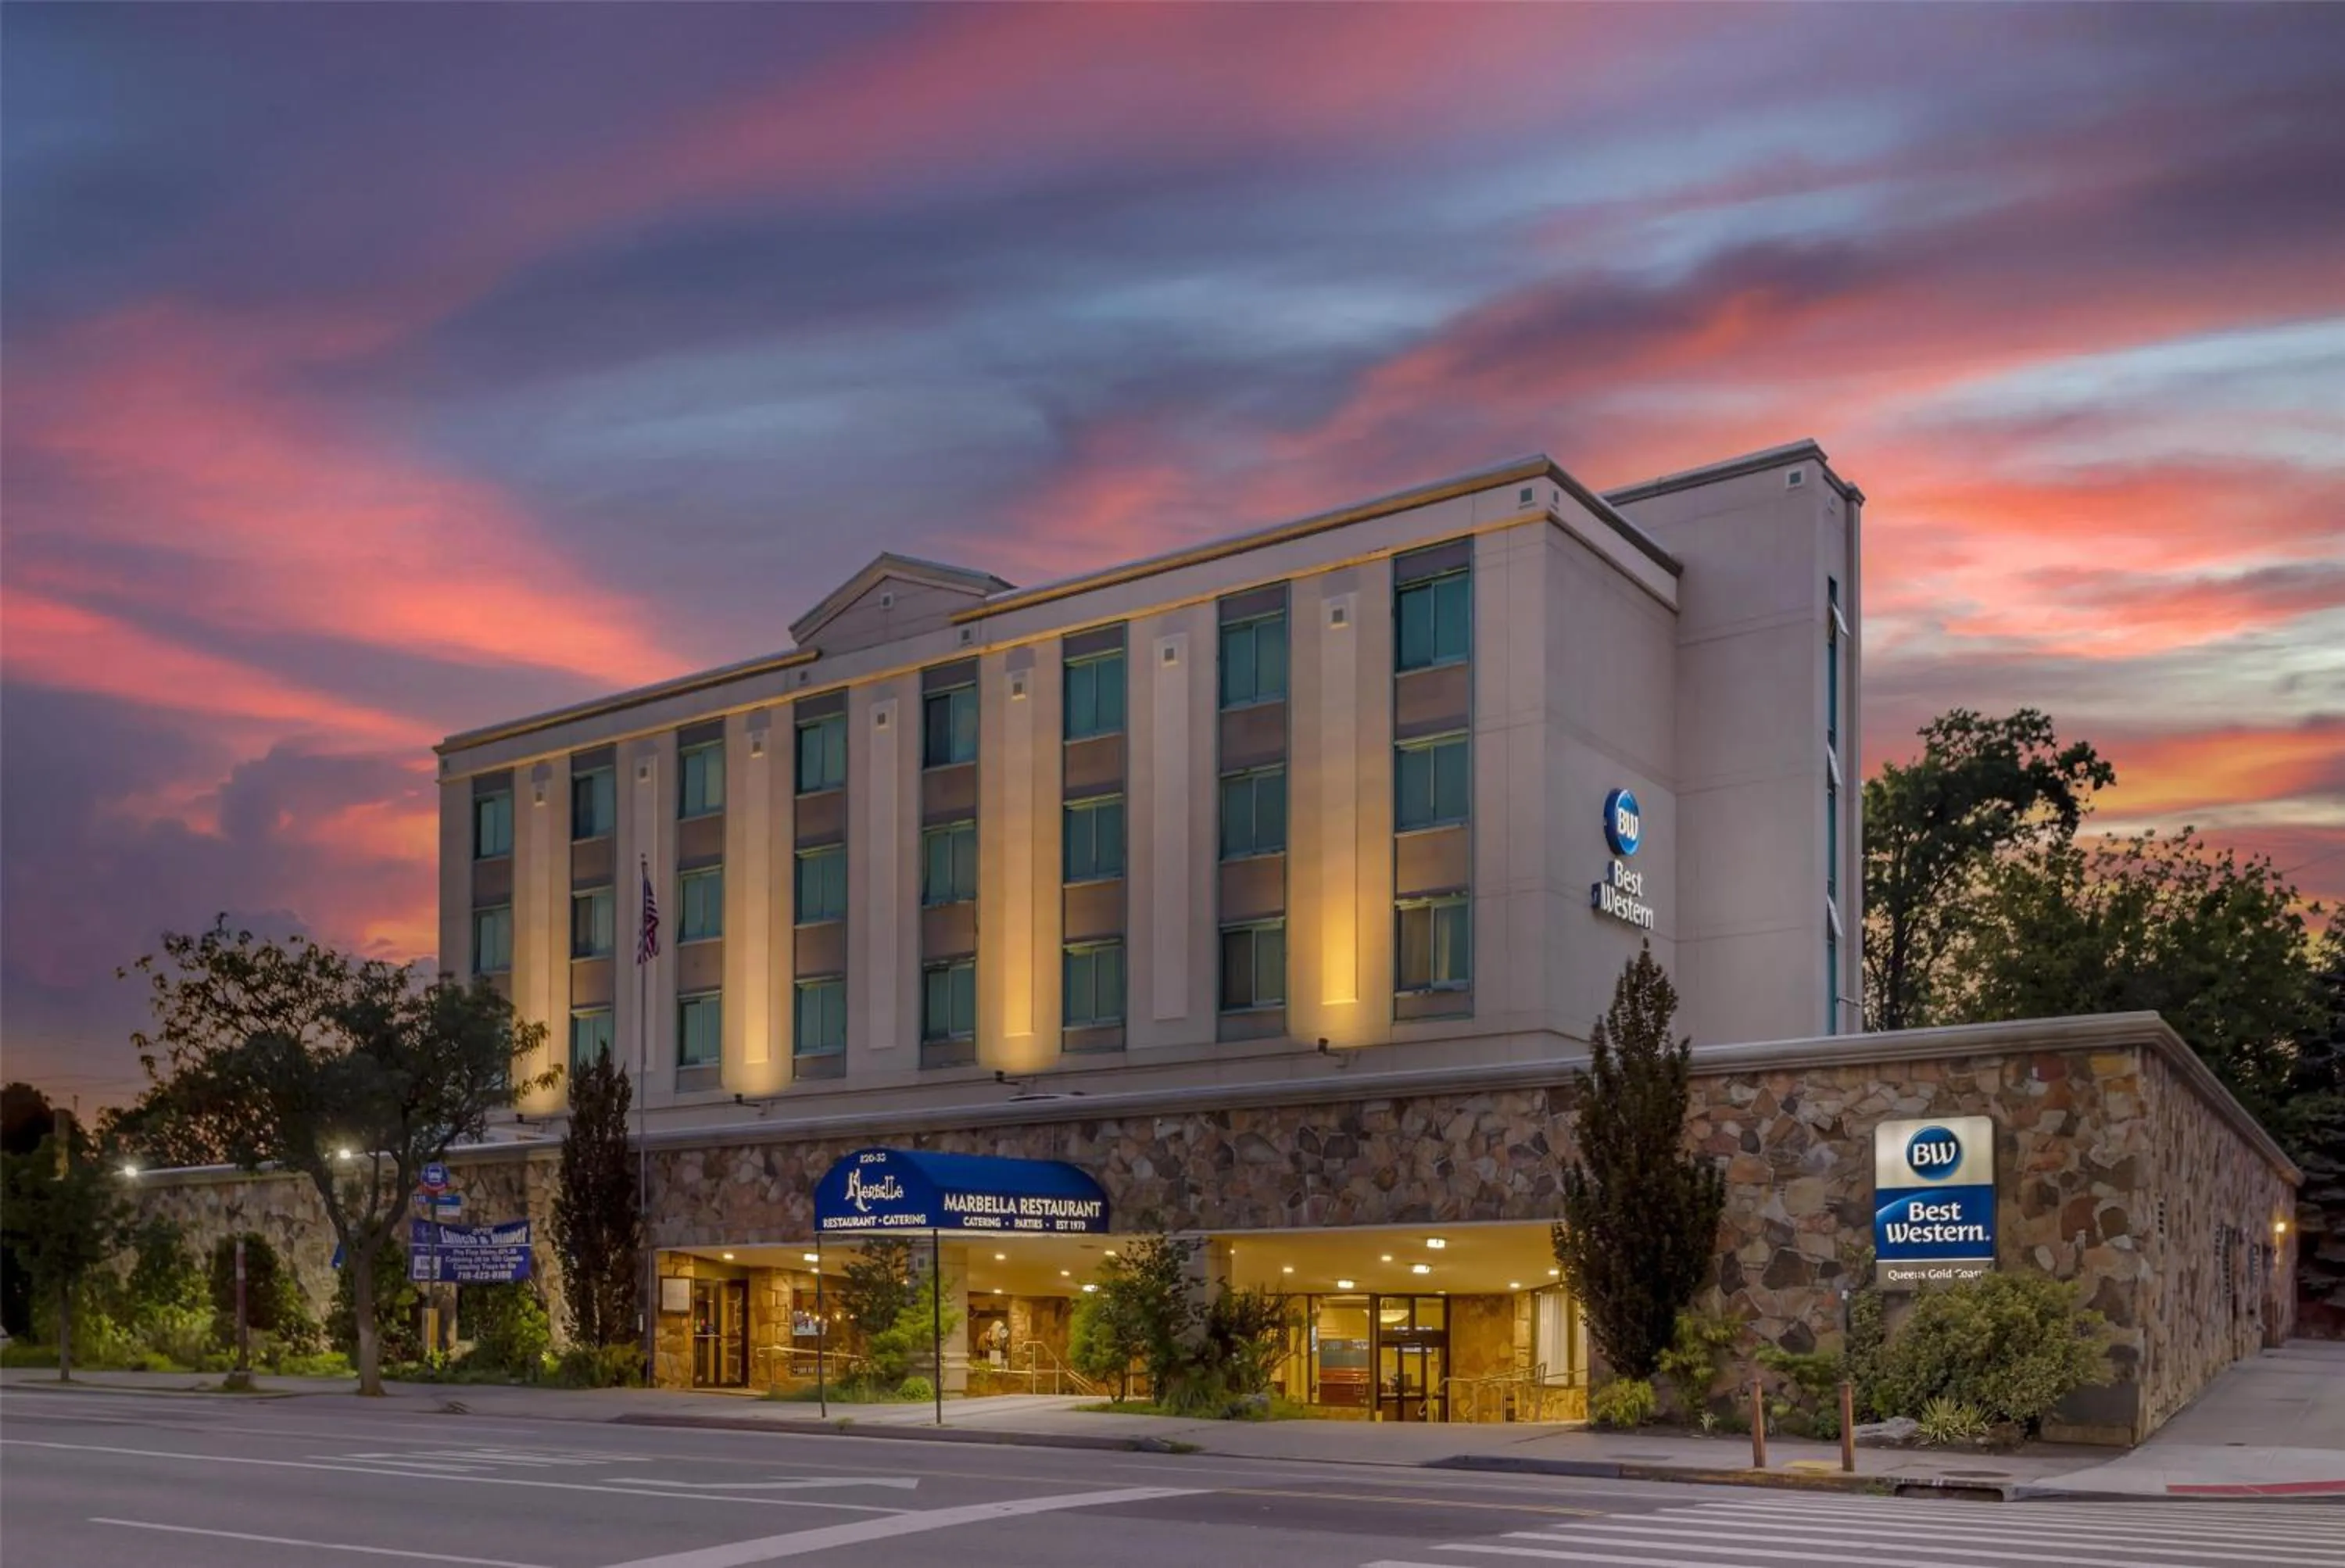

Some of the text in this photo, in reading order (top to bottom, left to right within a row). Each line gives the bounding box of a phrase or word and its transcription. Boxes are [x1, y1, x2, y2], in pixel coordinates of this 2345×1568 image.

[1617, 808, 1639, 840] BW
[1614, 860, 1642, 897] Best
[1600, 882, 1654, 929] Western
[1912, 1141, 1956, 1165] BW
[943, 1193, 1101, 1218] MARBELLA RESTAURANT
[1908, 1201, 1962, 1222] Best
[822, 1214, 926, 1228] RESTAURANT CATERING
[963, 1216, 1001, 1228] CATERING
[1885, 1223, 1985, 1244] Western
[1888, 1269, 1926, 1281] Queens
[1928, 1268, 1953, 1280] Gold
